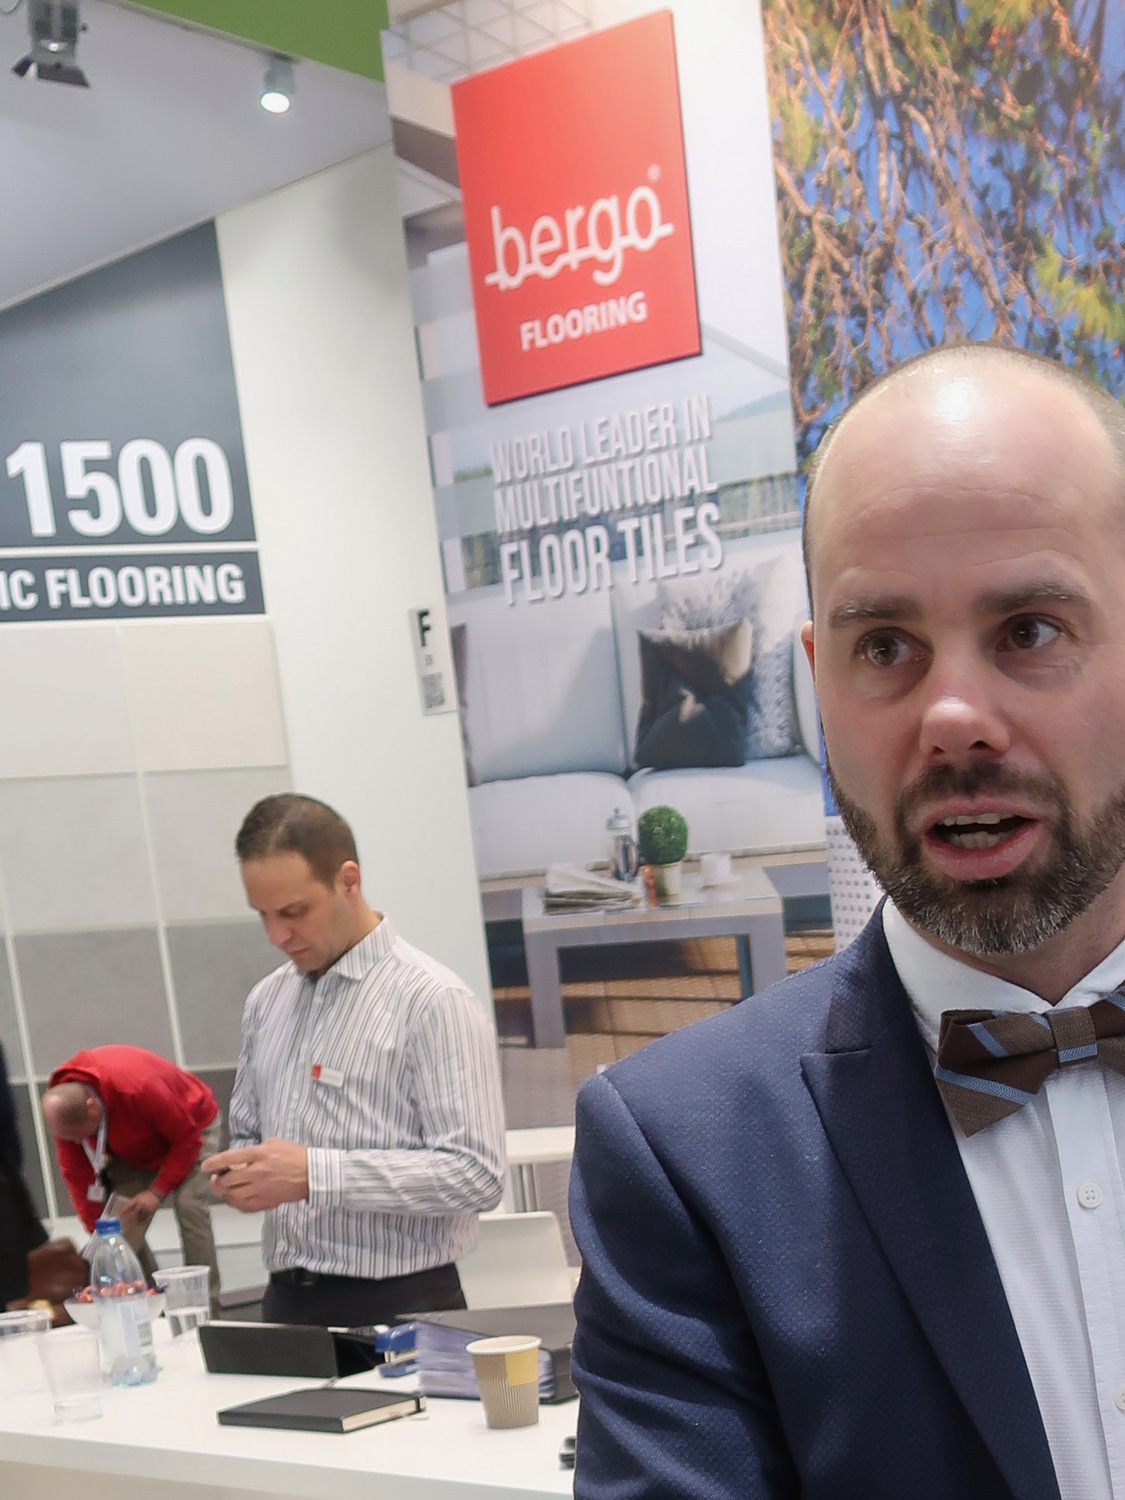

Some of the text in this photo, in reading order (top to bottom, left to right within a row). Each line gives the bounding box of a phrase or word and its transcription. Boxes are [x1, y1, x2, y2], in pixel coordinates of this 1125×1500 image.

[485, 185, 674, 290] bergo
[520, 291, 647, 351] FLOORING
[490, 394, 712, 484] WORLD LEADER IN
[5, 437, 235, 537] 1500
[493, 444, 718, 533] MULTIFUNTIONAL
[45, 563, 247, 609] FLOORING
[500, 502, 724, 607] FLOOR TILES
